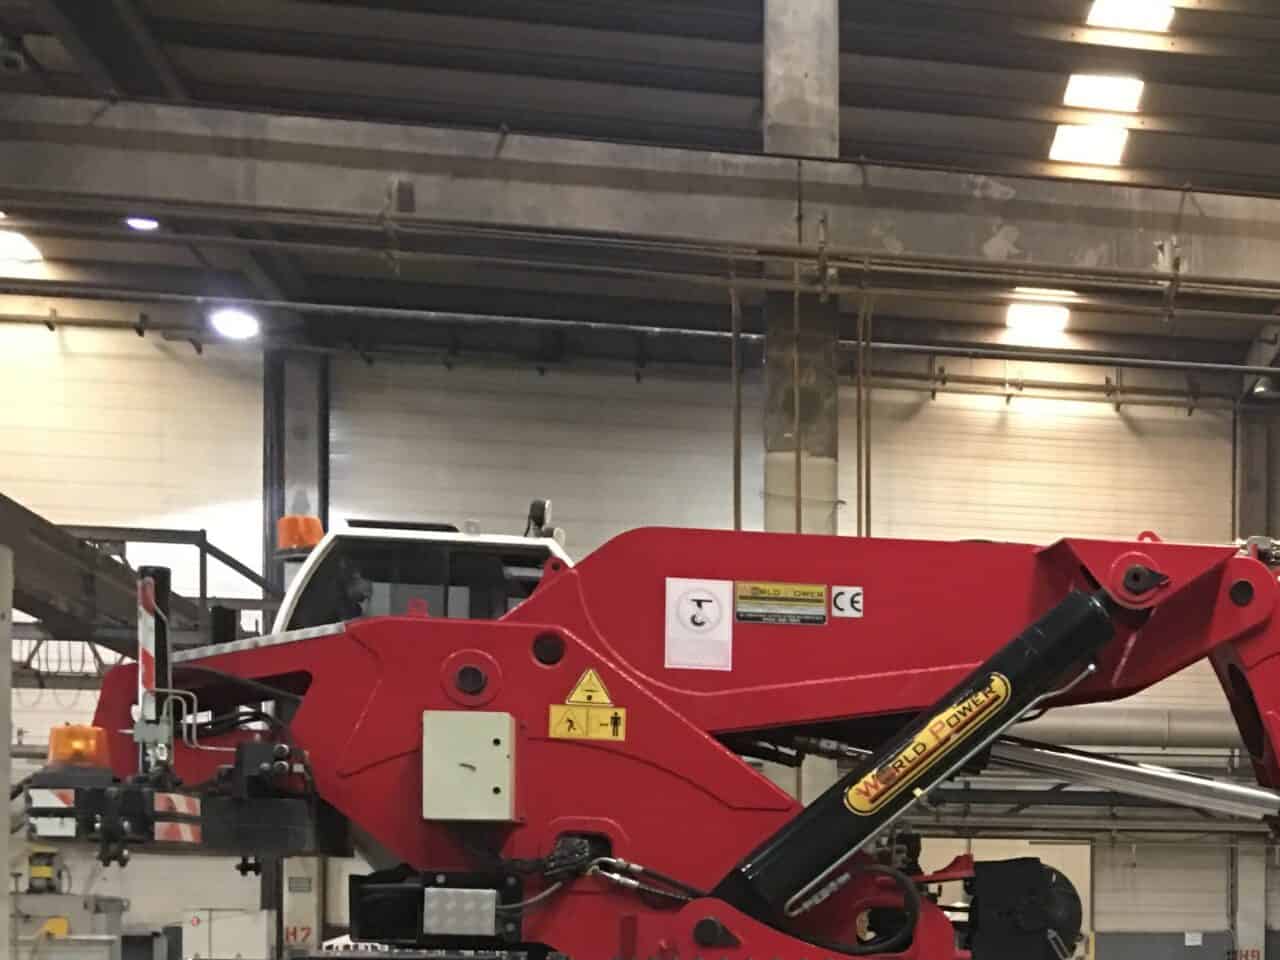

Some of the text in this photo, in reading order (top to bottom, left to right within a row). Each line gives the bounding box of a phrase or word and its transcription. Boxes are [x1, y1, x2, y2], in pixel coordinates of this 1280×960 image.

[833, 591, 862, 613] CE
[856, 686, 997, 797] WORLD POWER
[286, 927, 312, 944] H7
